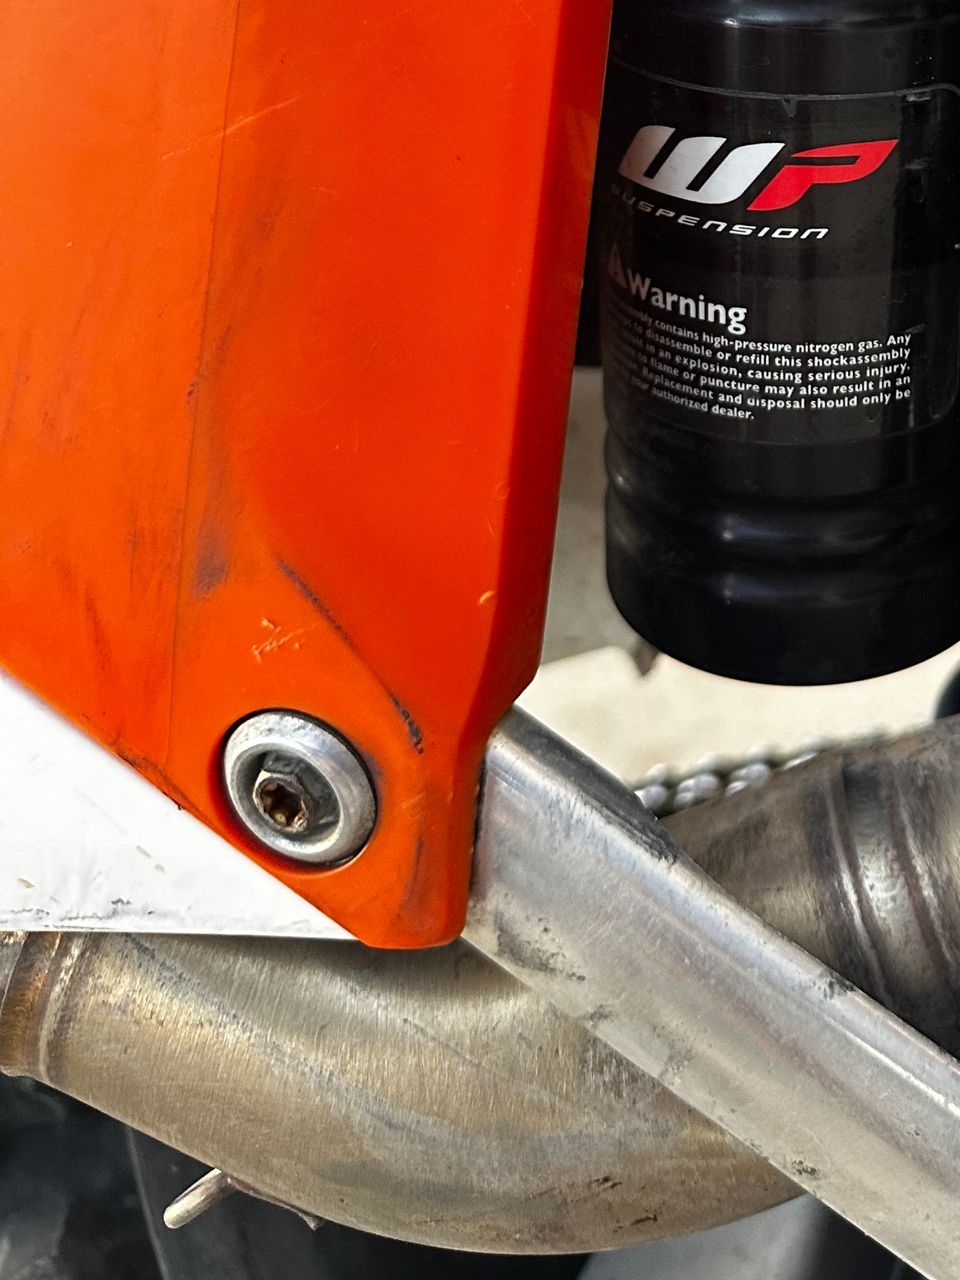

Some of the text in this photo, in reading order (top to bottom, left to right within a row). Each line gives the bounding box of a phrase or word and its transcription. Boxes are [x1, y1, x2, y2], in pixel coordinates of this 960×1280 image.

[618, 124, 899, 212] WP
[626, 267, 747, 335] Warning
[646, 329, 712, 357] disassemble
[717, 351, 731, 360] or
[736, 354, 769, 365] refill
[775, 355, 802, 367] this
[807, 347, 910, 367] shockassembly
[655, 319, 699, 340] contains
[702, 332, 792, 351] high-pressure
[796, 342, 854, 355] nitrogen
[858, 339, 882, 353] gas.
[887, 334, 911, 346] Any
[659, 348, 672, 360] an
[675, 354, 742, 378] explosion,
[747, 369, 802, 384] causing
[808, 369, 861, 381] serious
[866, 362, 910, 378] injury.
[651, 386, 754, 419] authorized dealer.
[682, 371, 696, 381] or
[700, 375, 760, 393] puncture
[764, 385, 794, 398] may
[799, 384, 828, 395] also
[833, 380, 874, 394] result
[879, 378, 891, 389] in
[895, 375, 911, 386] an
[718, 393, 743, 405] and
[747, 397, 805, 410] disposal
[810, 395, 857, 409] should
[862, 392, 891, 405] only
[895, 388, 911, 400] be
